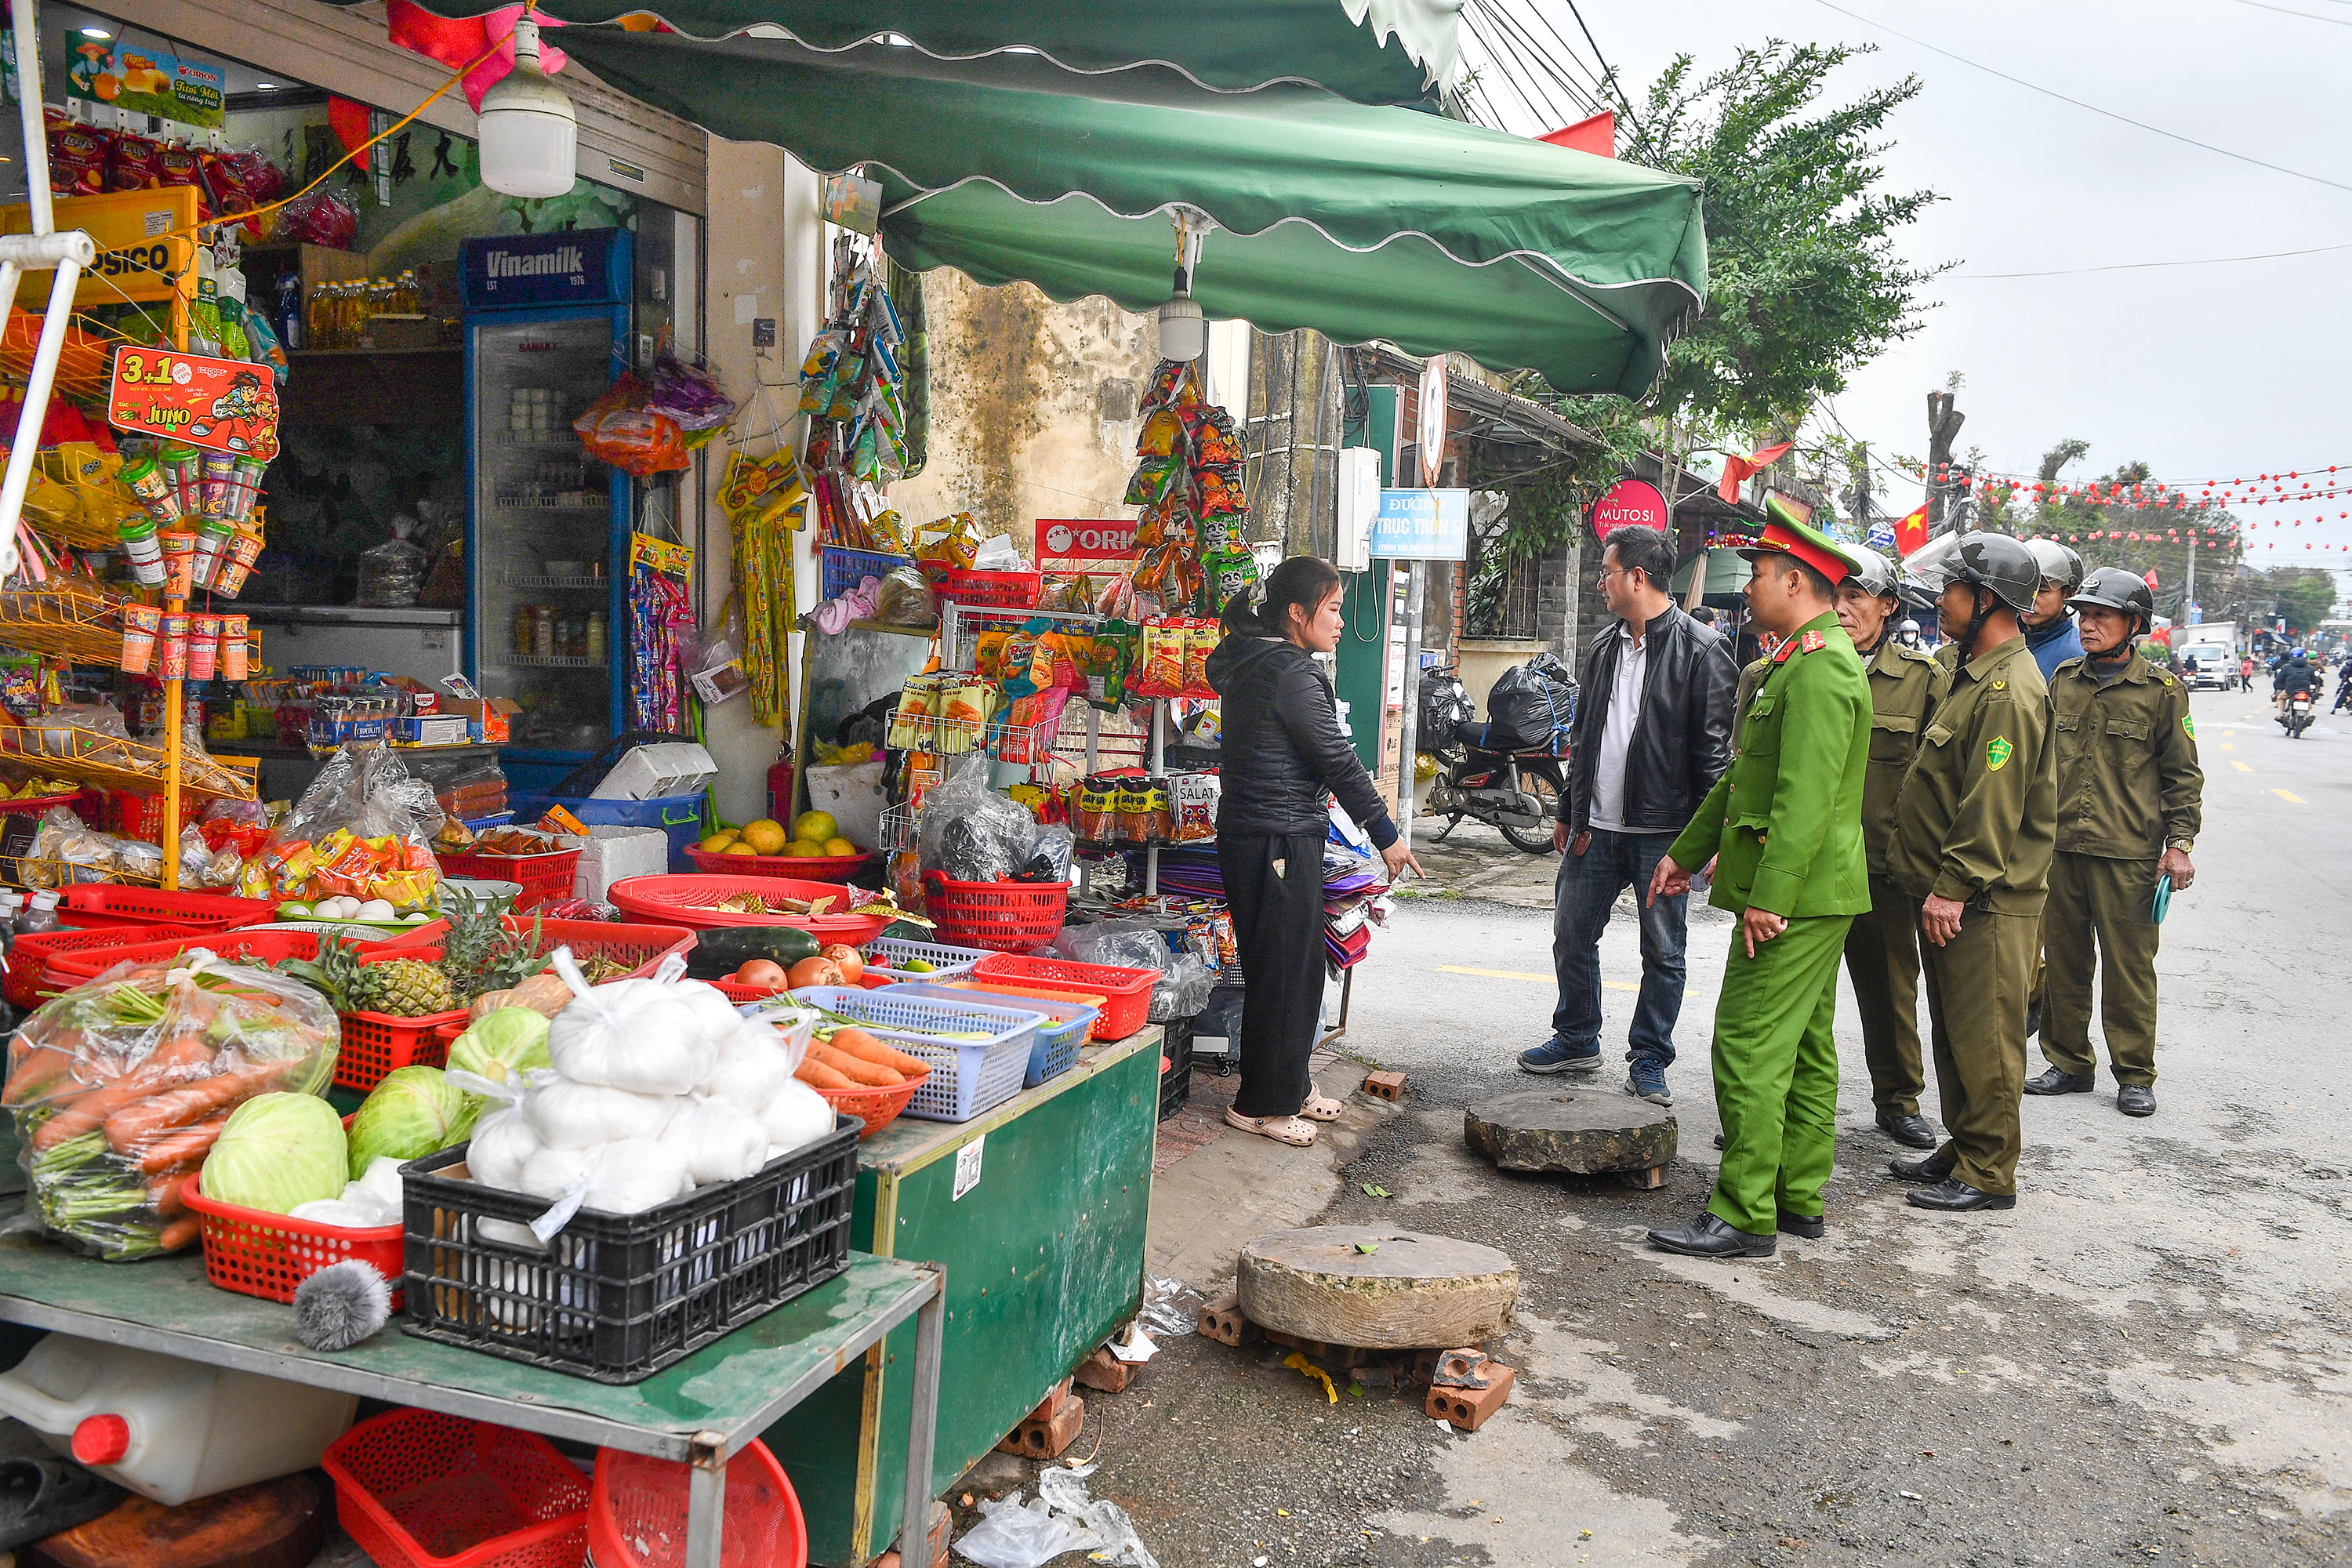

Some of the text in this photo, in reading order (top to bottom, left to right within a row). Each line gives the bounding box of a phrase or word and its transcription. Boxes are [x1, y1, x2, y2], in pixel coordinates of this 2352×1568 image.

[189, 68, 217, 82] ORION
[79, 245, 169, 278] PSICO
[487, 245, 583, 278] Vinamilk
[487, 281, 497, 291] EST
[570, 275, 585, 285] 1976
[122, 354, 172, 384] 3+1
[205, 367, 226, 376] FOODS
[145, 401, 191, 424] JUNO
[1599, 508, 1653, 522] MUTOSI
[1377, 517, 1410, 538] TRỤC
[1414, 515, 1448, 535] THÔN
[356, 726, 382, 737] CHOCOLATE
[1391, 739, 1397, 748] LG
[1180, 787, 1214, 800] SALAT
